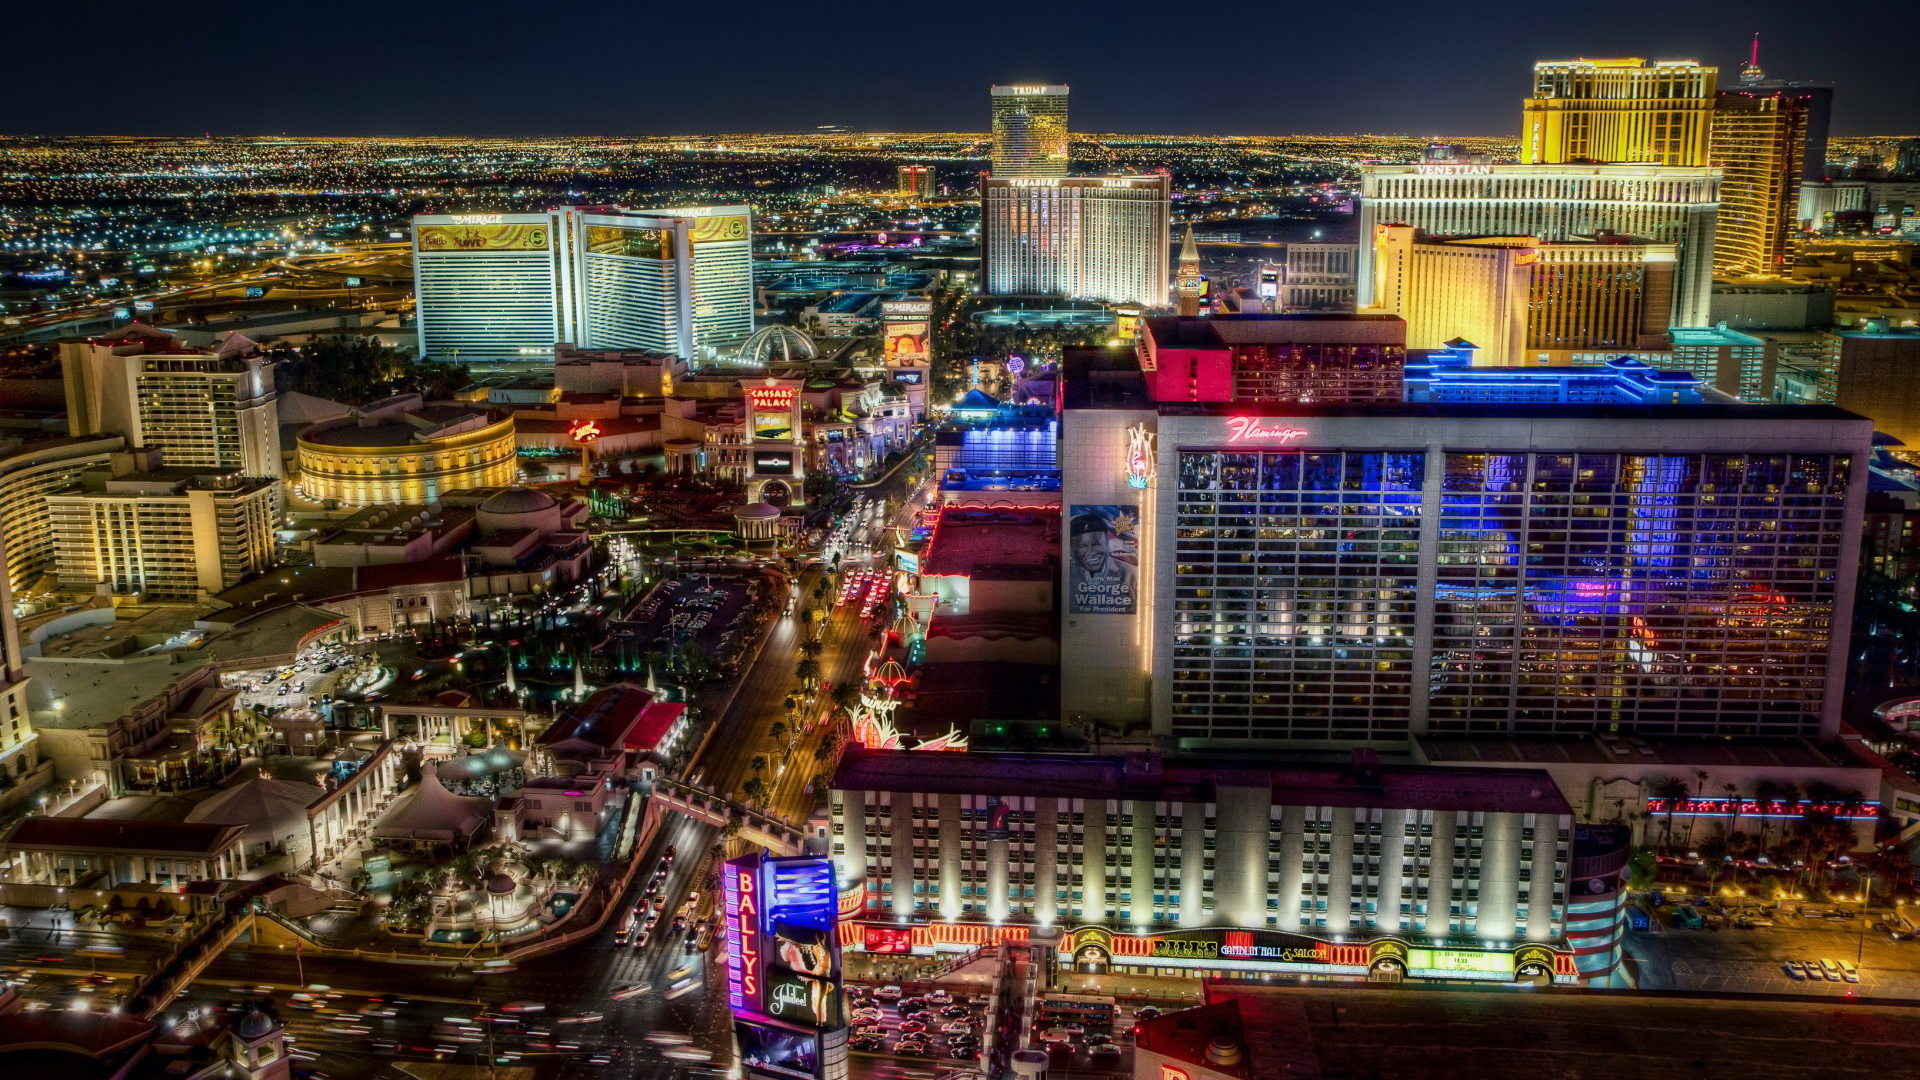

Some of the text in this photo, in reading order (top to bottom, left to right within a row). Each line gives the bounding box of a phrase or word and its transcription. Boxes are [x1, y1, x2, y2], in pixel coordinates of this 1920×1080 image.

[1012, 87, 1047, 95] TRUMP
[1416, 164, 1491, 175] VENETIAN
[1009, 178, 1060, 187] TREASURE
[673, 207, 712, 217] MIRAGE
[455, 215, 503, 225] MIRAGE
[459, 238, 482, 248] LOVE
[888, 303, 931, 312] MIRAGE
[754, 399, 791, 407] PALACE
[1226, 416, 1308, 444] Flamingo
[1078, 582, 1129, 595] George
[1075, 594, 1132, 605] Wallace
[739, 873, 757, 995] BALLYS
[1153, 940, 1218, 958] BILL'S
[1261, 947, 1282, 957] HALL
[1282, 948, 1294, 961] &
[1294, 948, 1327, 959] SALOON
